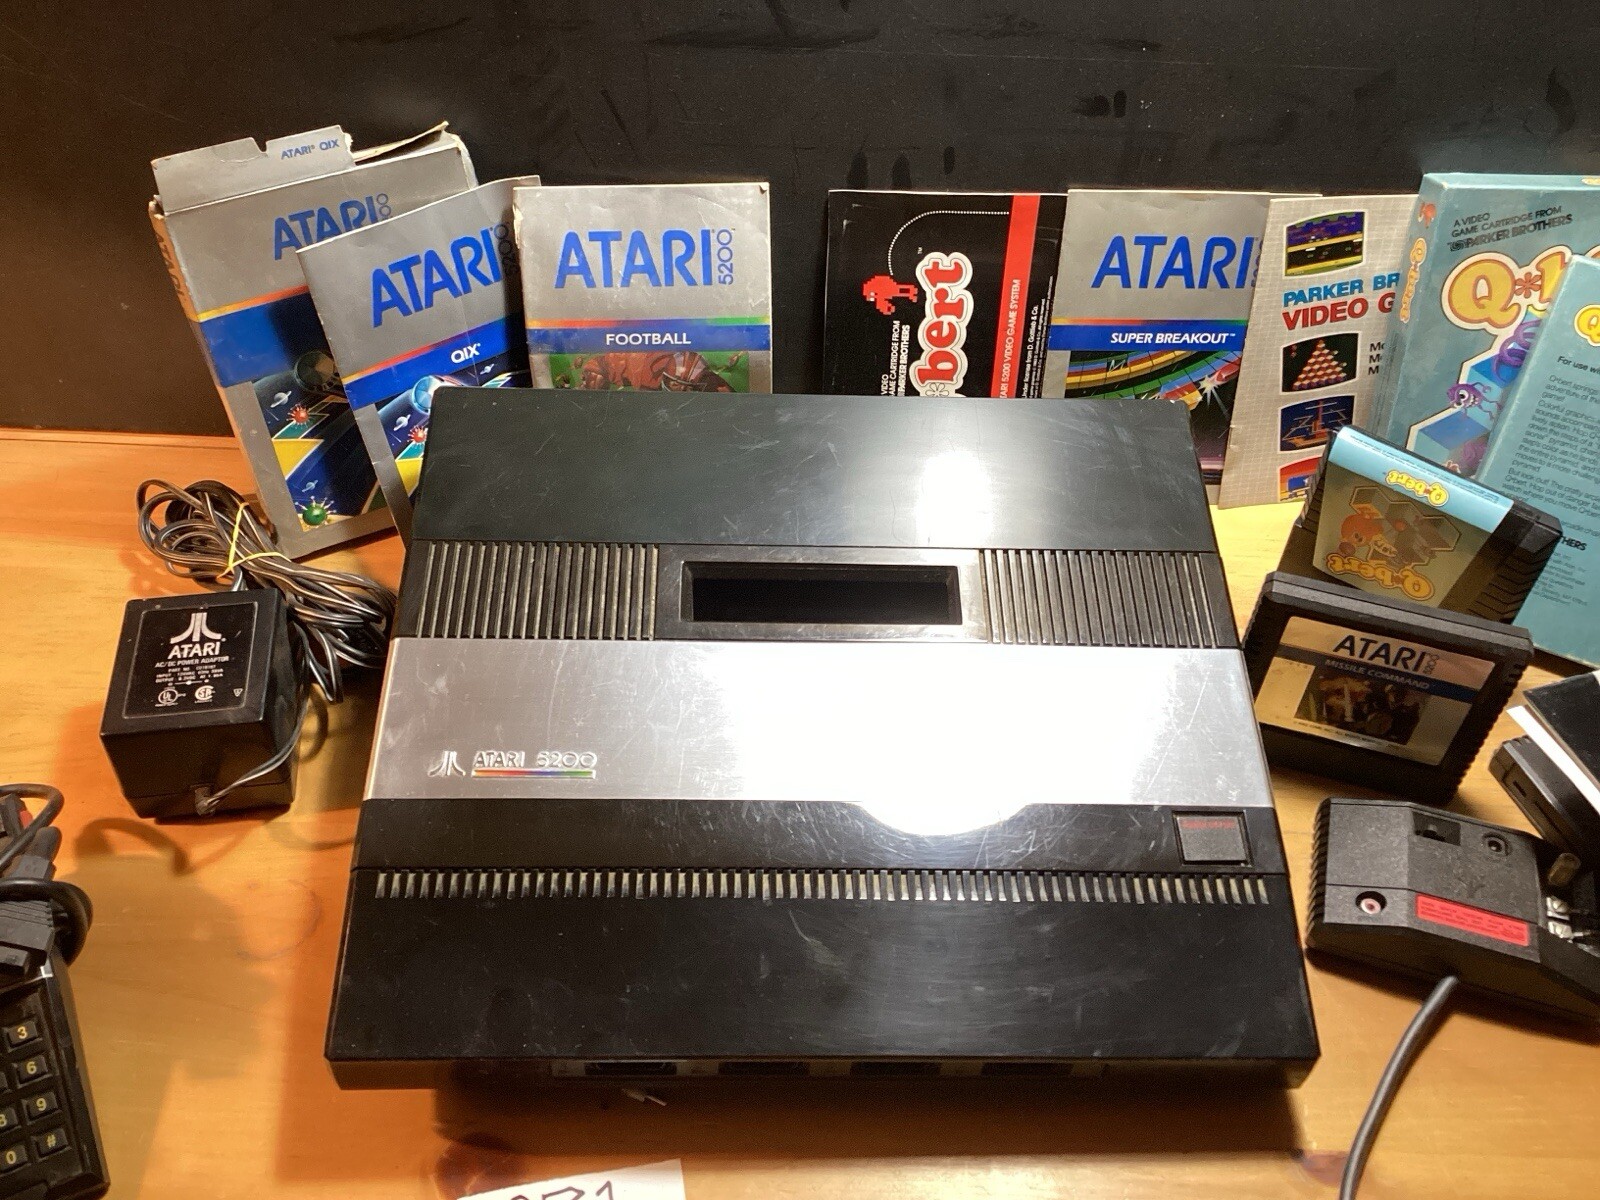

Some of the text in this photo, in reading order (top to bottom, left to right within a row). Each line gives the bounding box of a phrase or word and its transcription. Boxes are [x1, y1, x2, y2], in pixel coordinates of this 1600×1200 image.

[281, 138, 340, 160] ATARI QIX
[1451, 205, 1562, 238] GAME CARTRIDGE FROM
[1454, 212, 1490, 228] A VIDEO
[1466, 213, 1573, 247] PARKER BROTHERS
[554, 229, 714, 289] ATARI
[716, 228, 735, 286] 5200
[1091, 235, 1254, 289] ATARI
[372, 227, 503, 327] ATARI
[1283, 272, 1400, 307] PARKER BR
[1009, 279, 1021, 309] SYSTEM
[1006, 311, 1017, 336] GAME
[1282, 292, 1396, 331] VIDEO G
[892, 321, 900, 341] FROM
[1574, 304, 1600, 346] Q
[606, 332, 692, 346] FOOTBALL
[1003, 337, 1014, 362] VIDEO
[1111, 332, 1152, 344] SUPER
[451, 344, 479, 364] QIX
[890, 342, 898, 379] CARTRIDGE
[898, 325, 910, 391] PARKER BROTHERS
[1557, 355, 1573, 366] For
[1573, 362, 1588, 371] use
[1001, 363, 1011, 382] 5200
[167, 641, 221, 660] ATARI
[1333, 634, 1428, 673] ATARI
[1325, 659, 1430, 690] MISSILE COMMAND
[472, 750, 598, 768] ATARI 5200
[18, 1026, 28, 1039] 3
[26, 1061, 37, 1074] 6
[36, 1097, 47, 1111] 9
[6, 1150, 17, 1165] 0
